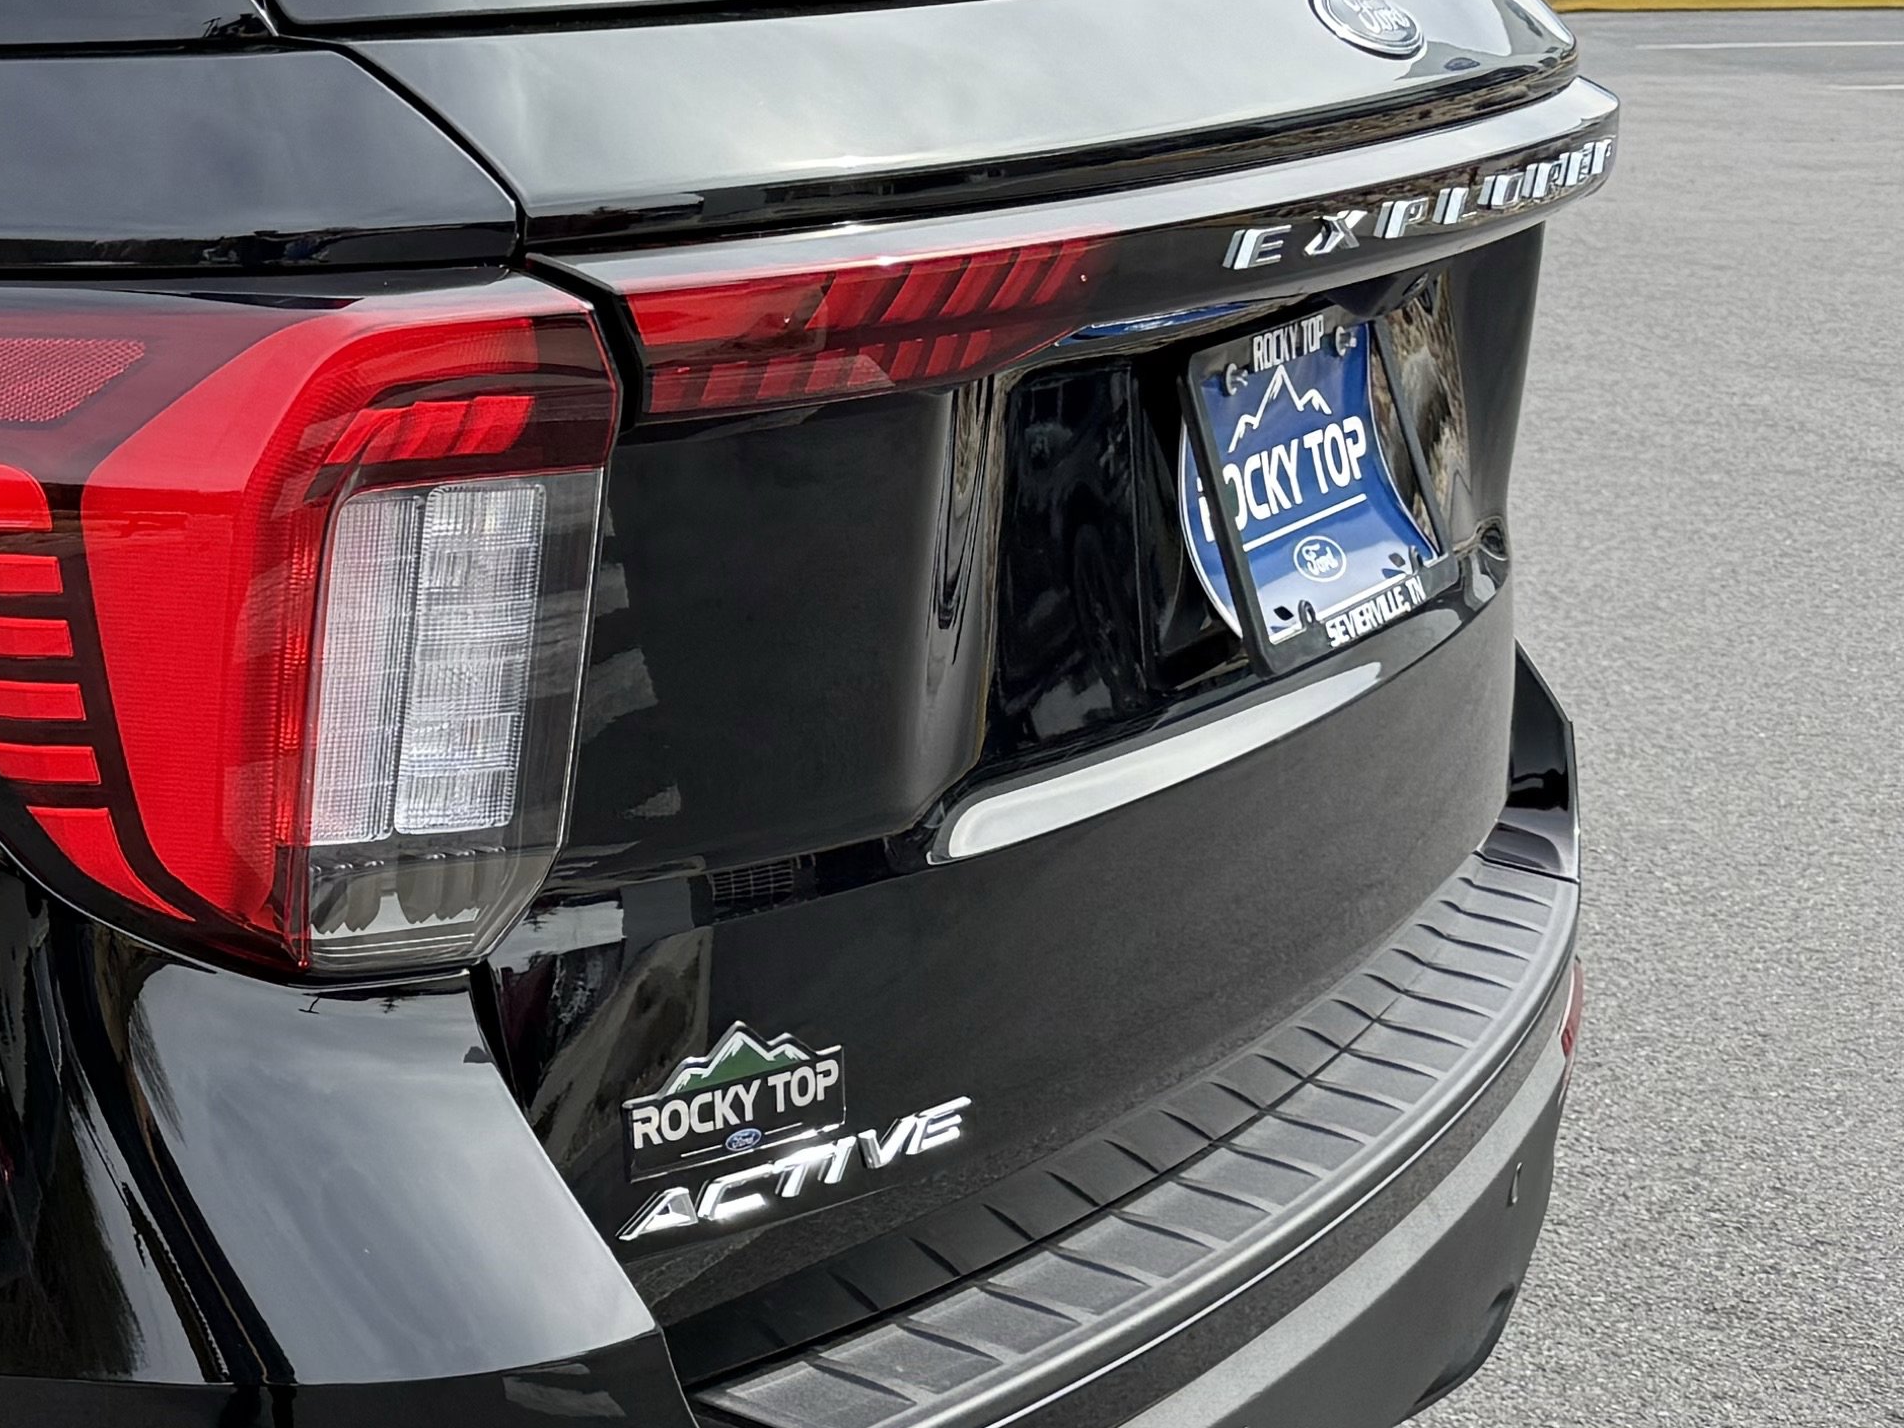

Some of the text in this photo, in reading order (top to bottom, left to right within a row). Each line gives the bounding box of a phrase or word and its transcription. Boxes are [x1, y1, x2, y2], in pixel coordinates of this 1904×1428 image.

[1222, 138, 1616, 270] EXPLORER
[1253, 313, 1325, 373] ROCKY TOP
[1304, 416, 1367, 495] TOP
[1405, 575, 1427, 606] TN
[632, 1058, 840, 1150] ROCKY TOP
[616, 1095, 973, 1242] ACTIVE
